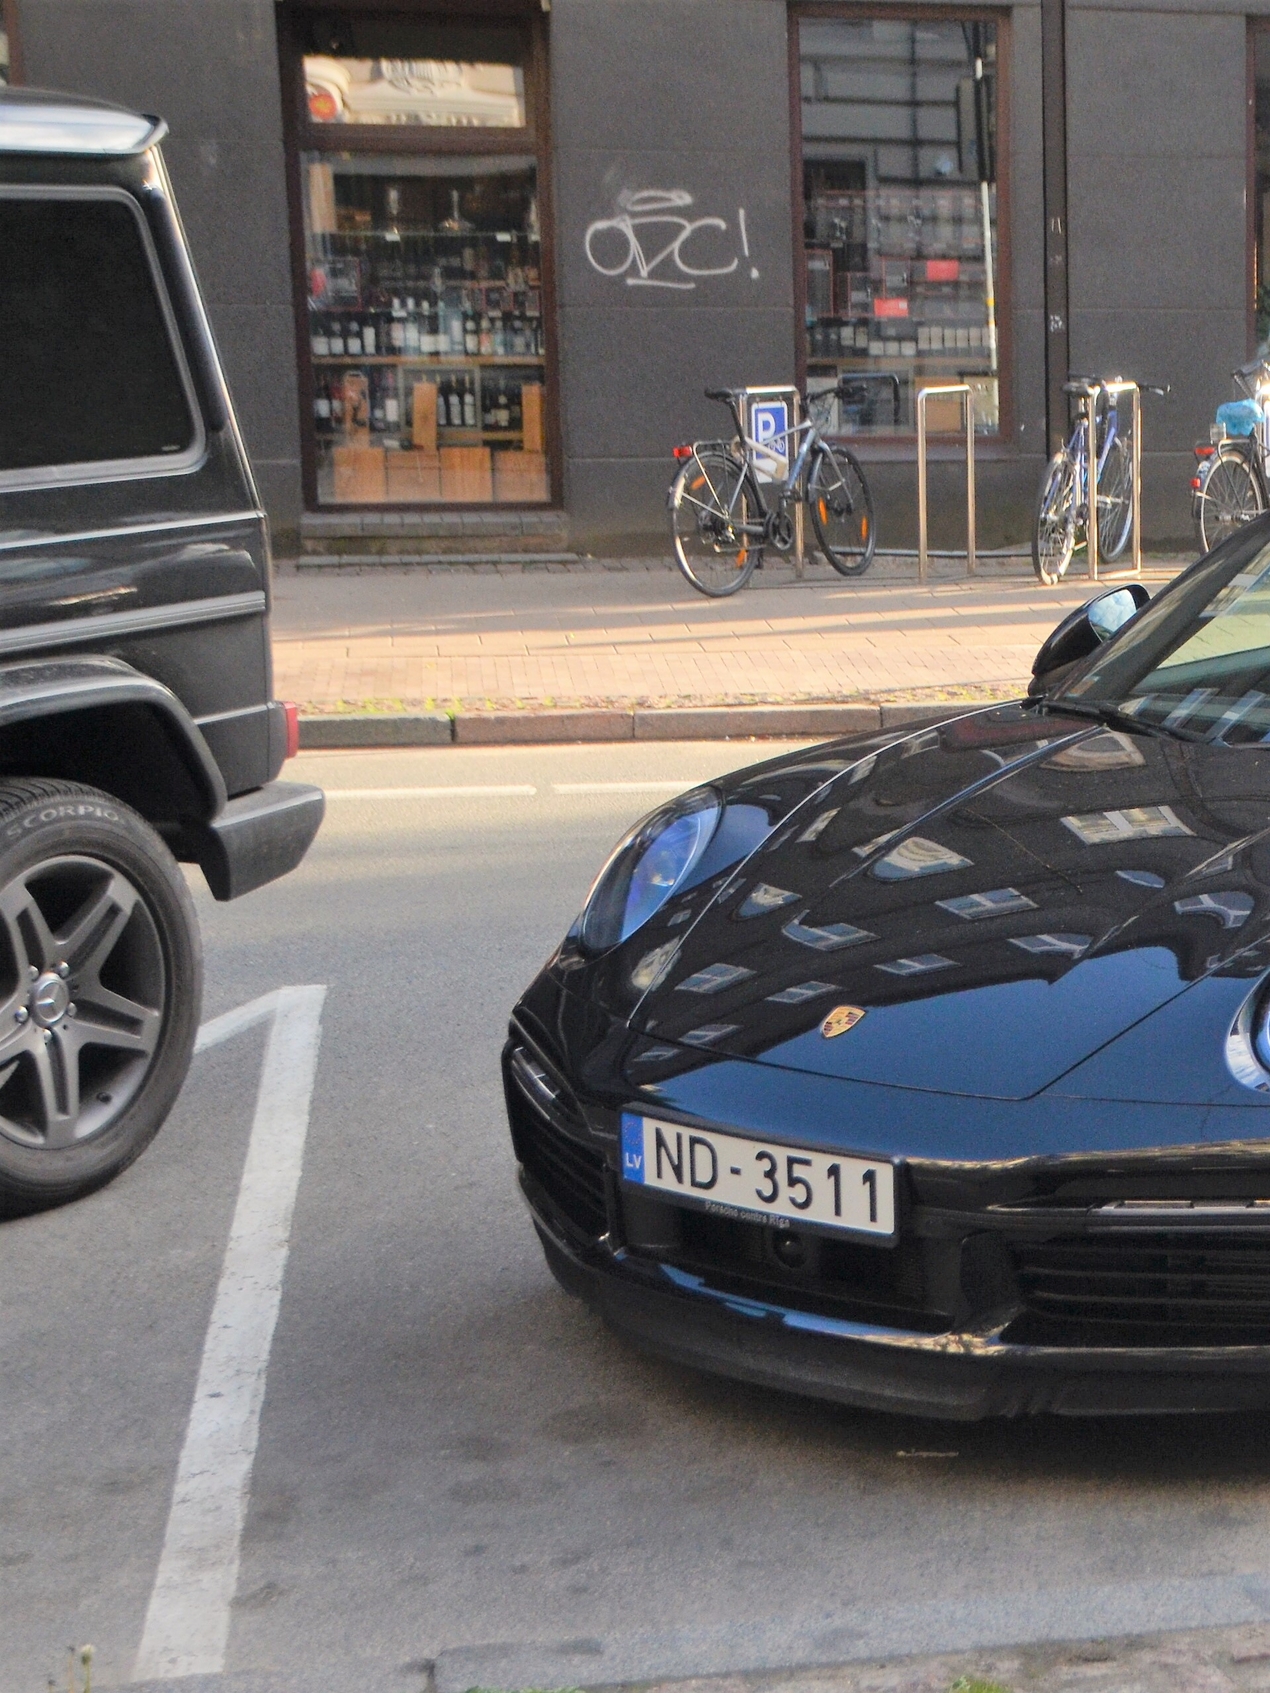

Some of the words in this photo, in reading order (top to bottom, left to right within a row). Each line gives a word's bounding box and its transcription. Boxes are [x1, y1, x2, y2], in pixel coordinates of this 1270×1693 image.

[758, 411, 776, 444] P
[7, 804, 126, 836] SCORPIO
[625, 1152, 642, 1169] LV
[655, 1126, 878, 1223] ND-3511
